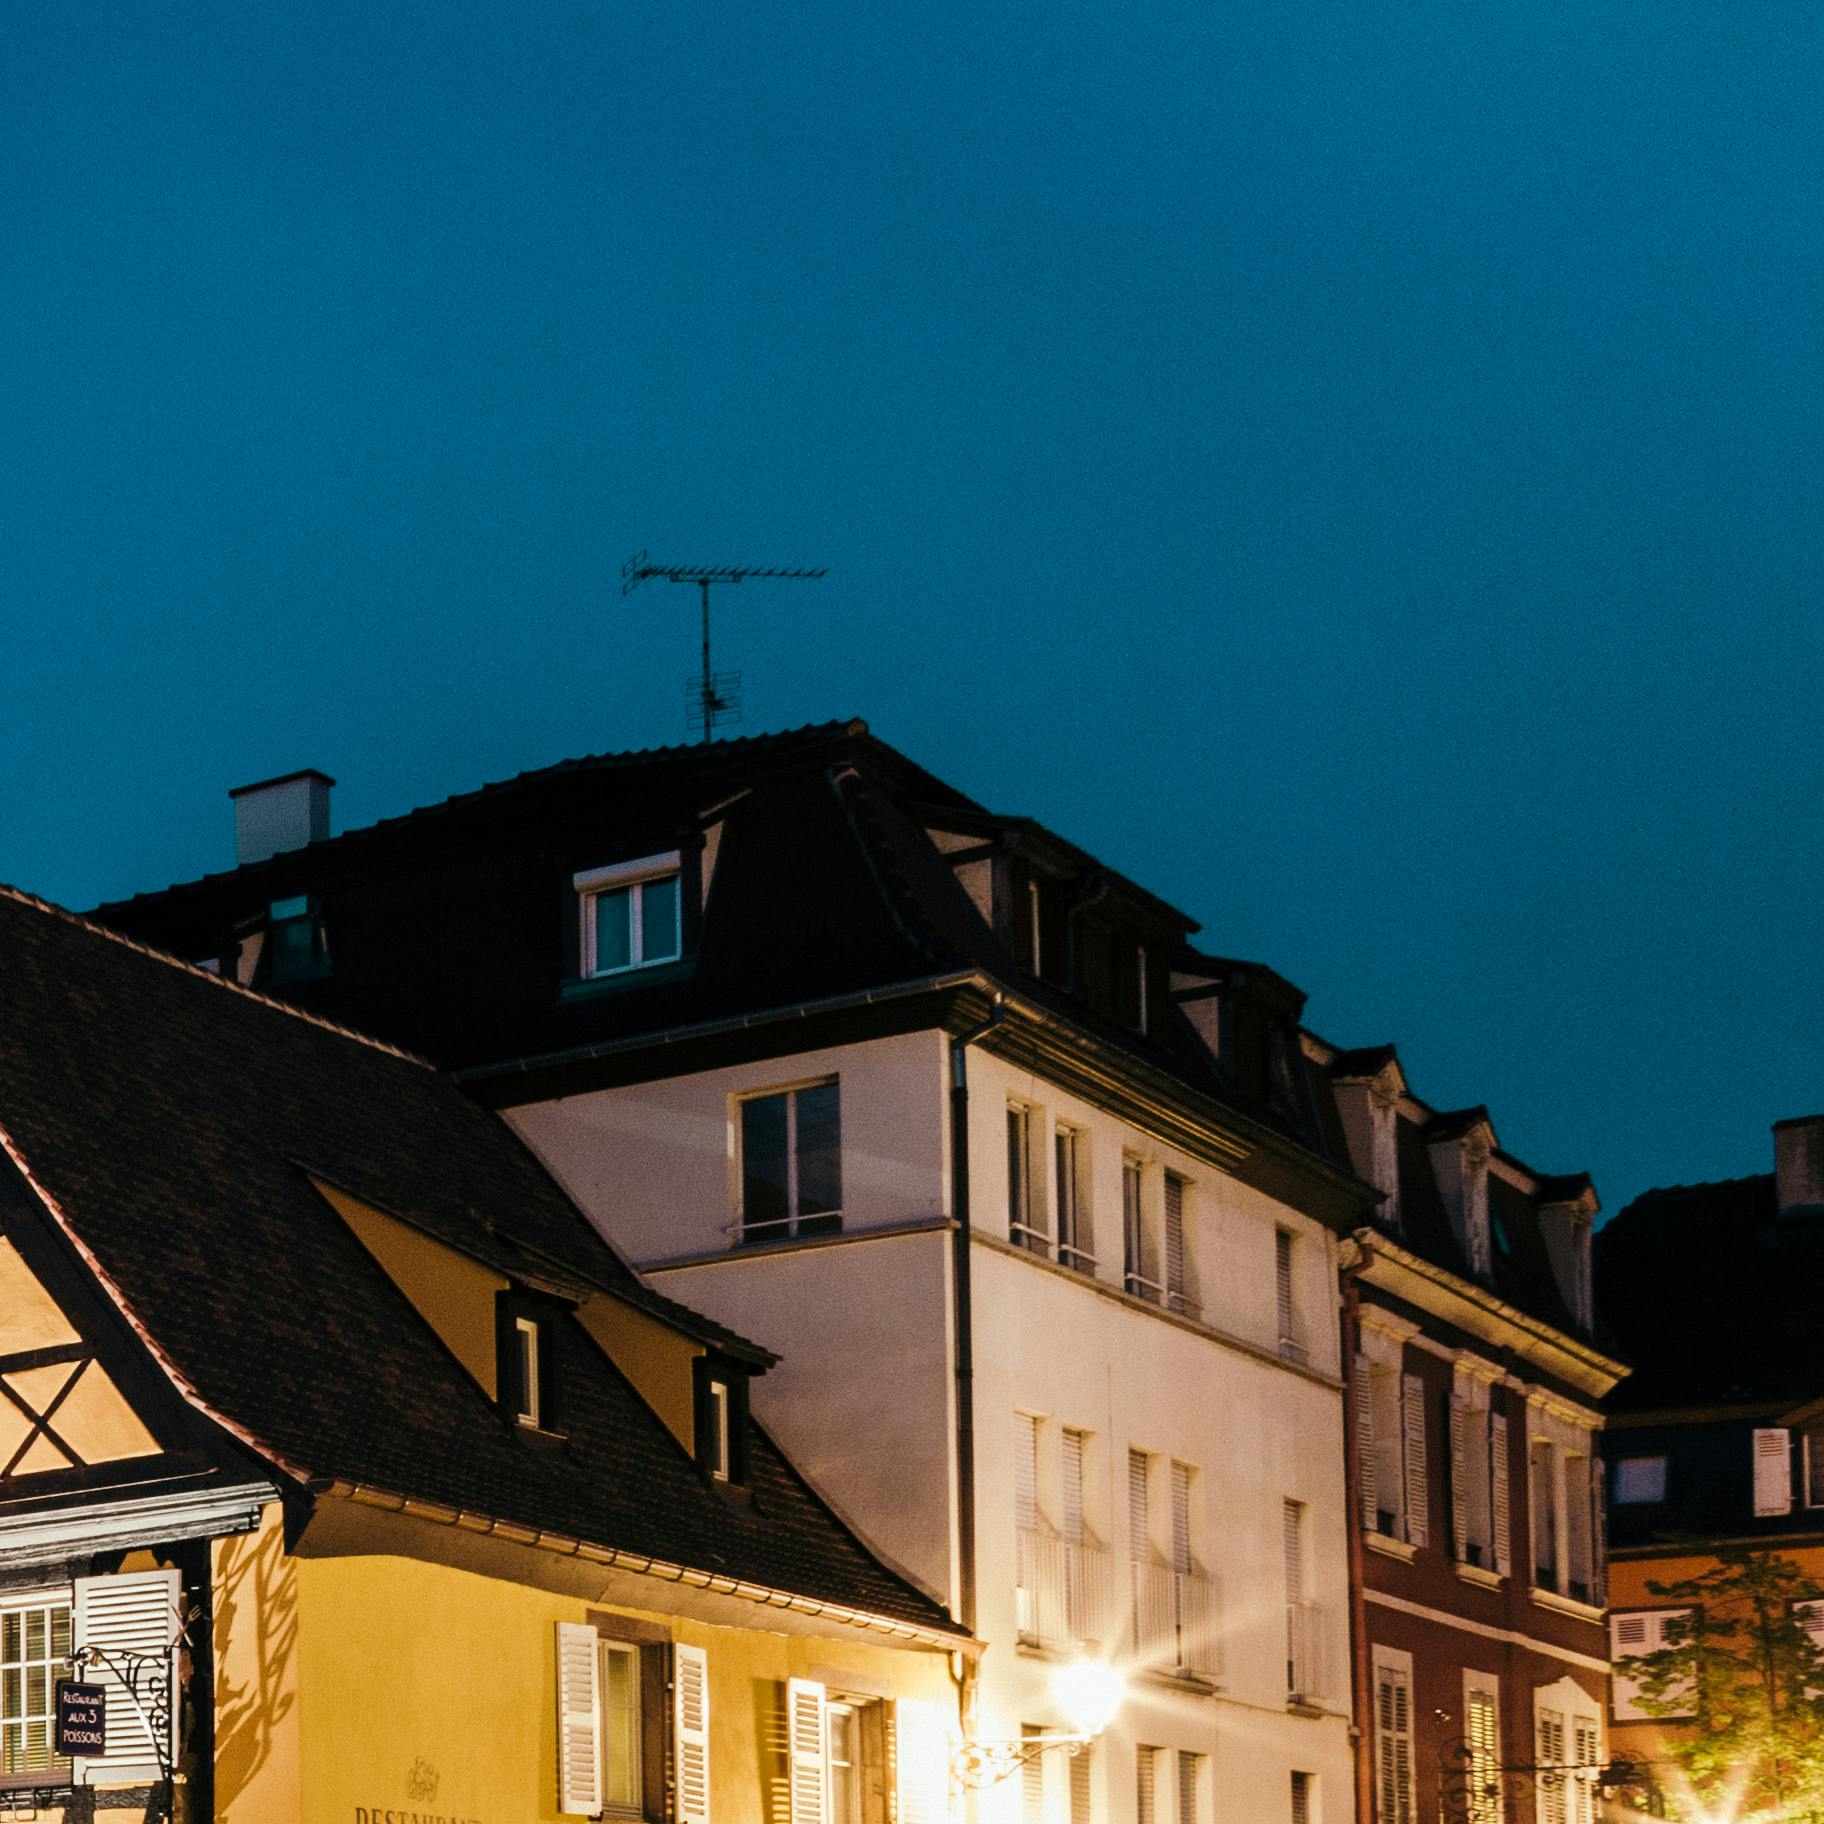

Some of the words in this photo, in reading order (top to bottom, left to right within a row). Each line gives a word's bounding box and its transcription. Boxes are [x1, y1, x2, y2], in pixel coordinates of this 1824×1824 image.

[68, 1712, 87, 1723] AUX
[88, 1709, 97, 1723] 3
[63, 1729, 103, 1744] POISSONS
